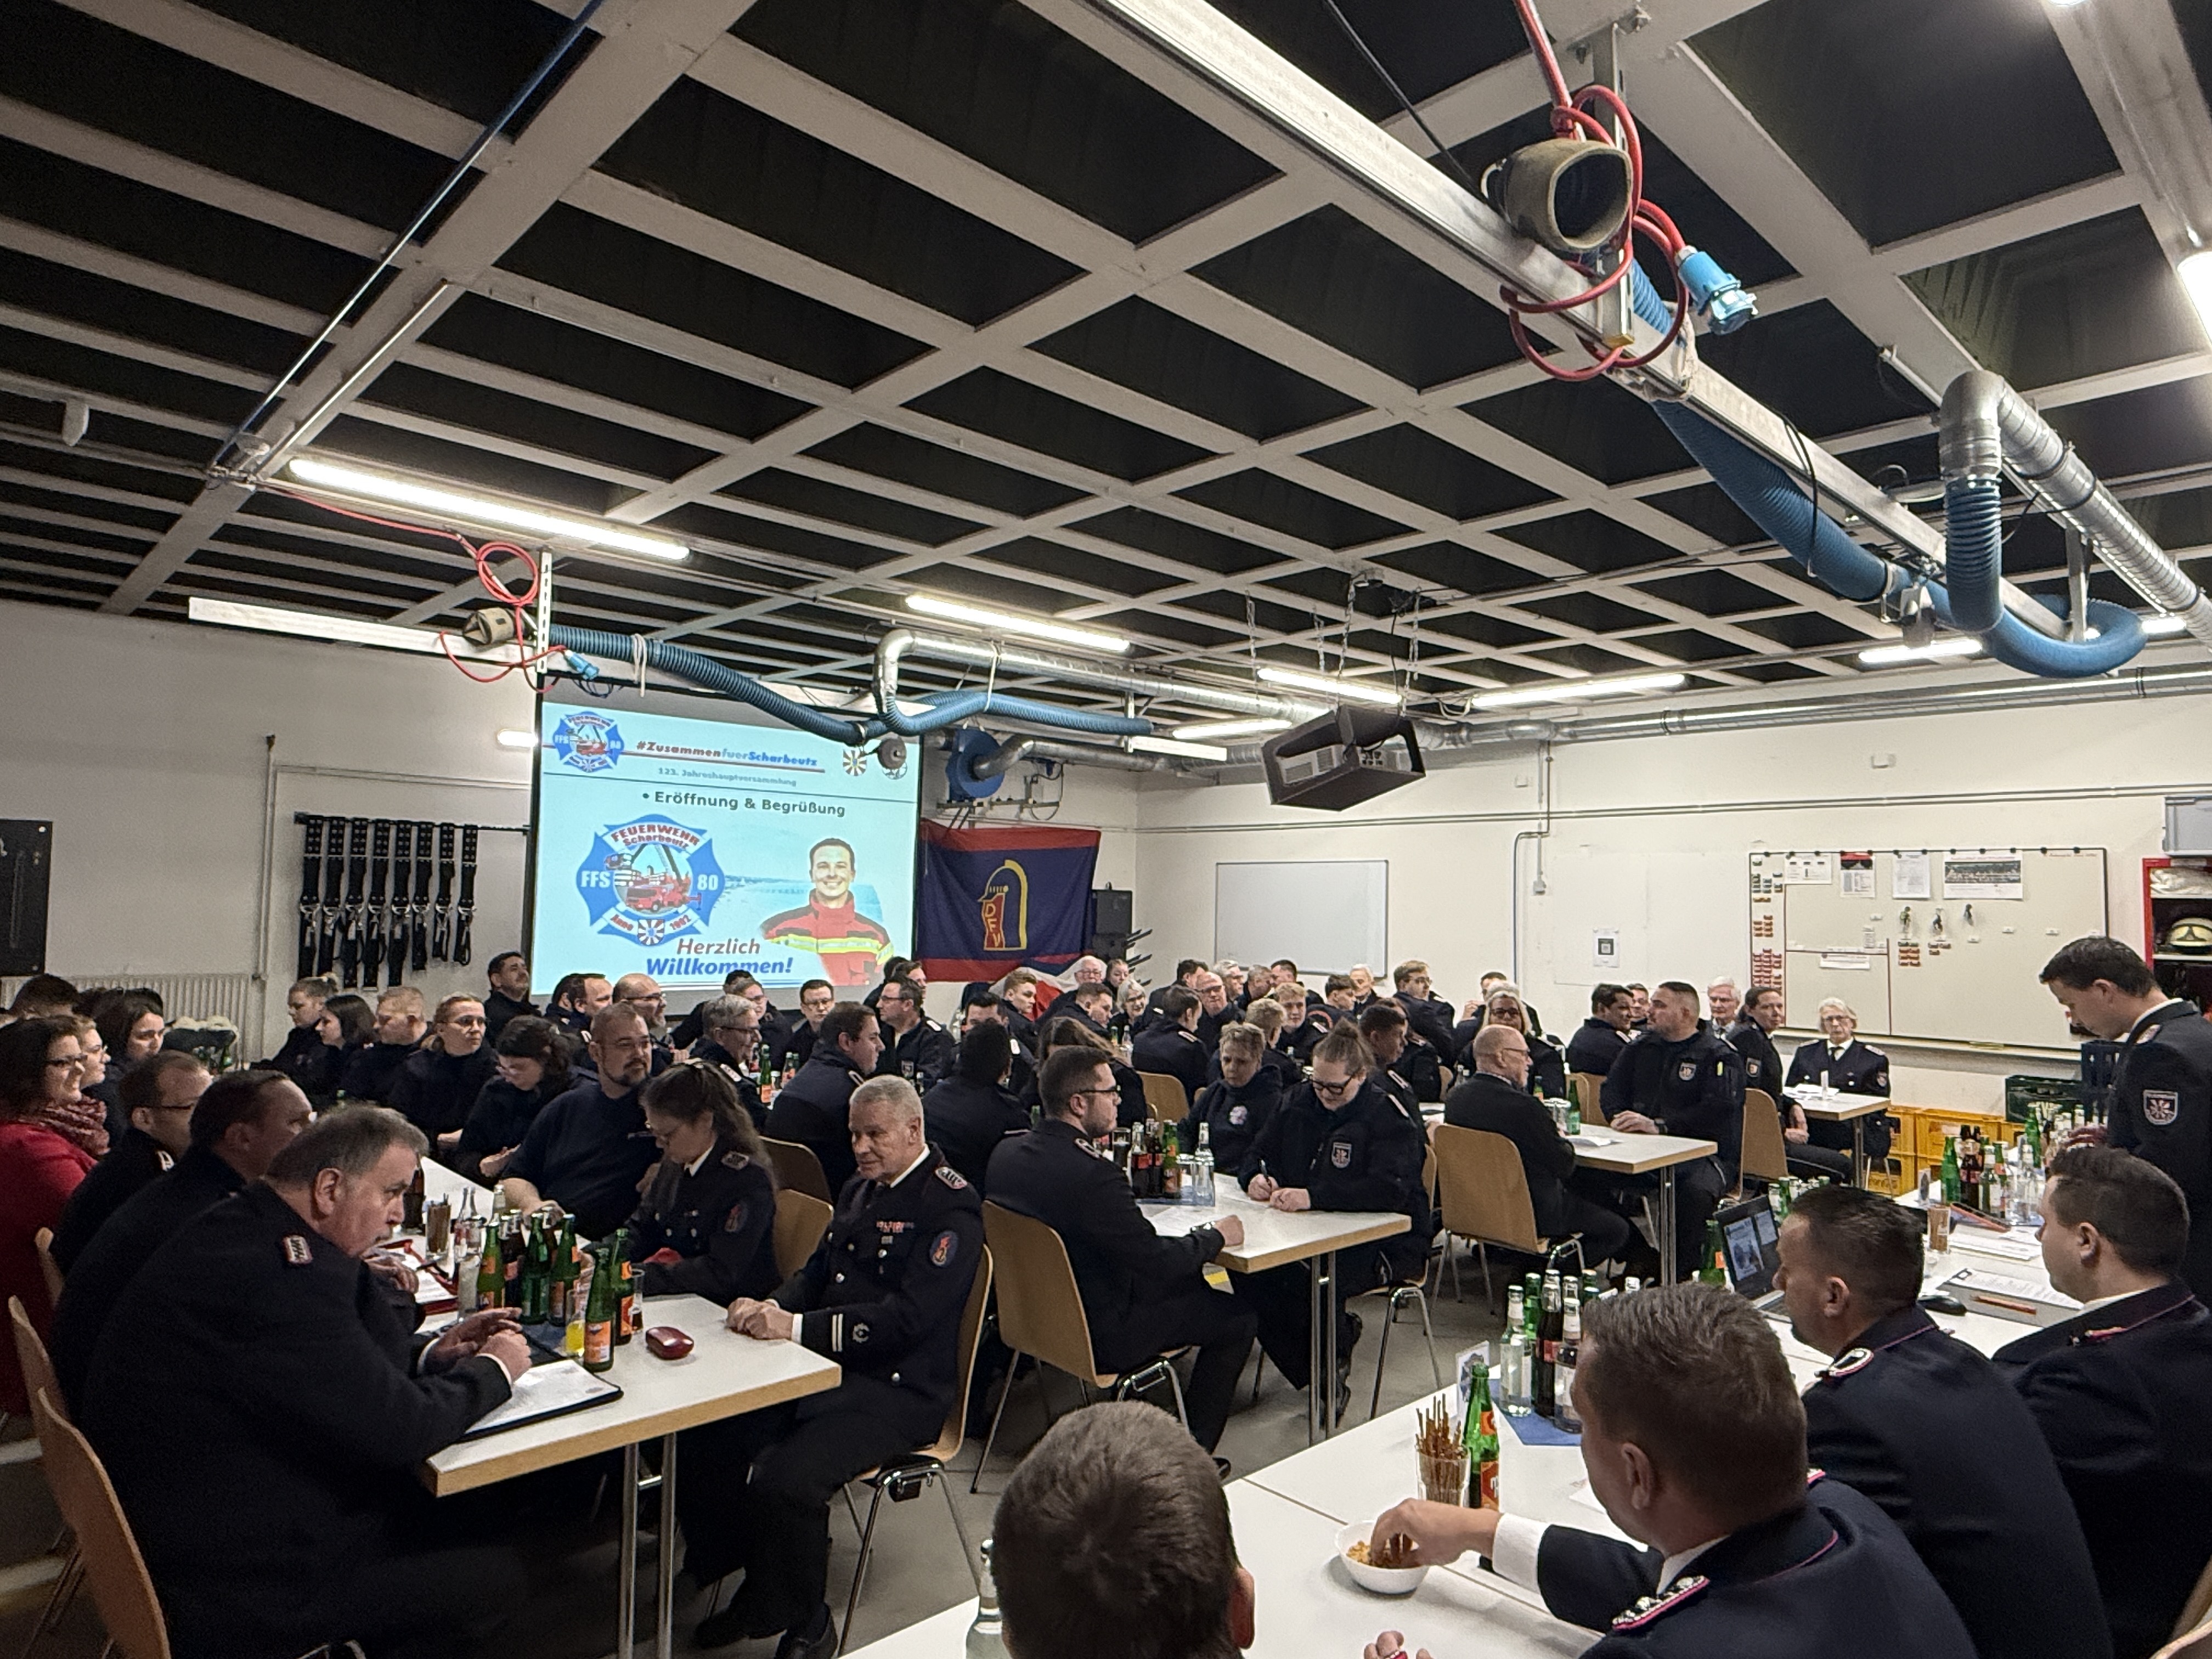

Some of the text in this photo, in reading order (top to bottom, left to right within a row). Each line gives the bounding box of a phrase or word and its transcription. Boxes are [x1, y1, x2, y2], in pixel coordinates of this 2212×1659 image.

[636, 741, 817, 766] #ZusammenfuerScharbeutz
[681, 769, 797, 787] Jahreshauptversammlung
[654, 791, 845, 817] Eröffnung & Begrüßung
[610, 824, 700, 846] FEUERWEHR
[581, 870, 611, 888] FFS
[697, 874, 719, 890] 80
[984, 903, 1001, 947] DFV
[676, 938, 760, 955] Herzlich
[646, 957, 793, 975] Willkommen!
